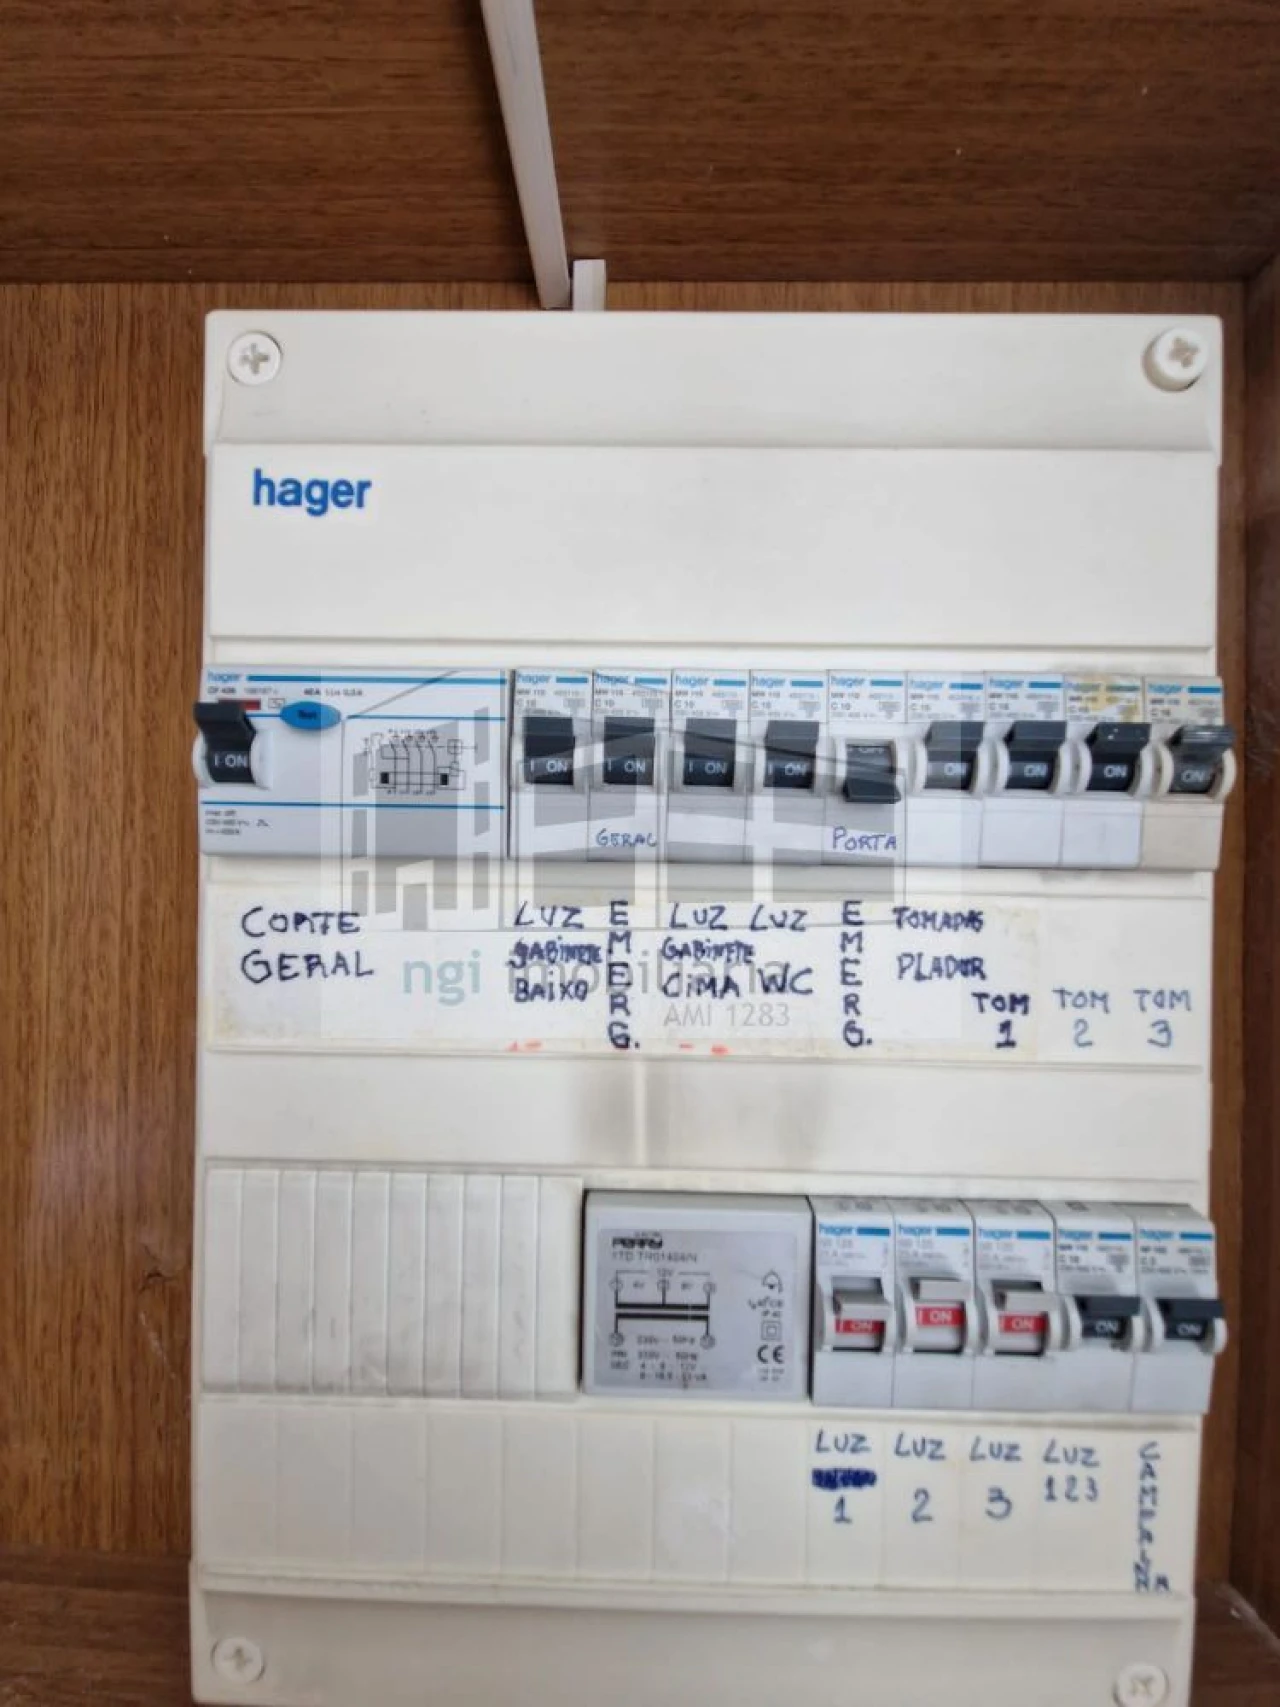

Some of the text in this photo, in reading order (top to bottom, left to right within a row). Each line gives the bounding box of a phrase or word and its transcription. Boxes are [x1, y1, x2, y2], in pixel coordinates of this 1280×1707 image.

[253, 468, 372, 517] hager
[207, 671, 241, 684] hager
[516, 673, 550, 686] hager
[675, 675, 709, 688] hager
[752, 676, 786, 688] hager
[831, 676, 865, 688] hager
[989, 677, 1024, 689] hager
[910, 680, 944, 691] hager
[1148, 683, 1182, 695] hager
[225, 752, 248, 768] ON
[546, 761, 568, 773] ON
[624, 761, 646, 773] ON
[704, 762, 727, 774] ON
[785, 762, 808, 775] ON
[943, 762, 969, 775] ON
[1024, 763, 1048, 778] ON
[1104, 764, 1128, 778] ON
[1181, 769, 1207, 783] ON
[832, 826, 897, 851] PORTA
[241, 906, 360, 938] CORTE
[515, 901, 584, 929] LUZ
[669, 903, 727, 930] LUZ
[750, 905, 808, 931] LUZ
[241, 949, 374, 984] GERAL
[759, 963, 813, 996] WC
[971, 992, 1030, 1014] TOM
[1052, 988, 1110, 1013] TOM
[1133, 989, 1192, 1012] TOM
[995, 1020, 1017, 1049] 1
[1073, 1018, 1095, 1048] 2
[1147, 1020, 1173, 1048] 3
[819, 1223, 852, 1236] hager
[978, 1228, 1013, 1240] hager
[929, 1309, 951, 1323] ON
[850, 1321, 873, 1333] ON
[1011, 1317, 1034, 1331] ON
[1095, 1320, 1119, 1334] ON
[815, 1428, 871, 1453] LUZ
[894, 1429, 947, 1461] LUZ
[969, 1436, 1023, 1462] LUZ
[1043, 1439, 1101, 1468] LUZ
[833, 1495, 853, 1524] 1
[911, 1487, 934, 1523] 2
[984, 1487, 1014, 1521] 3
